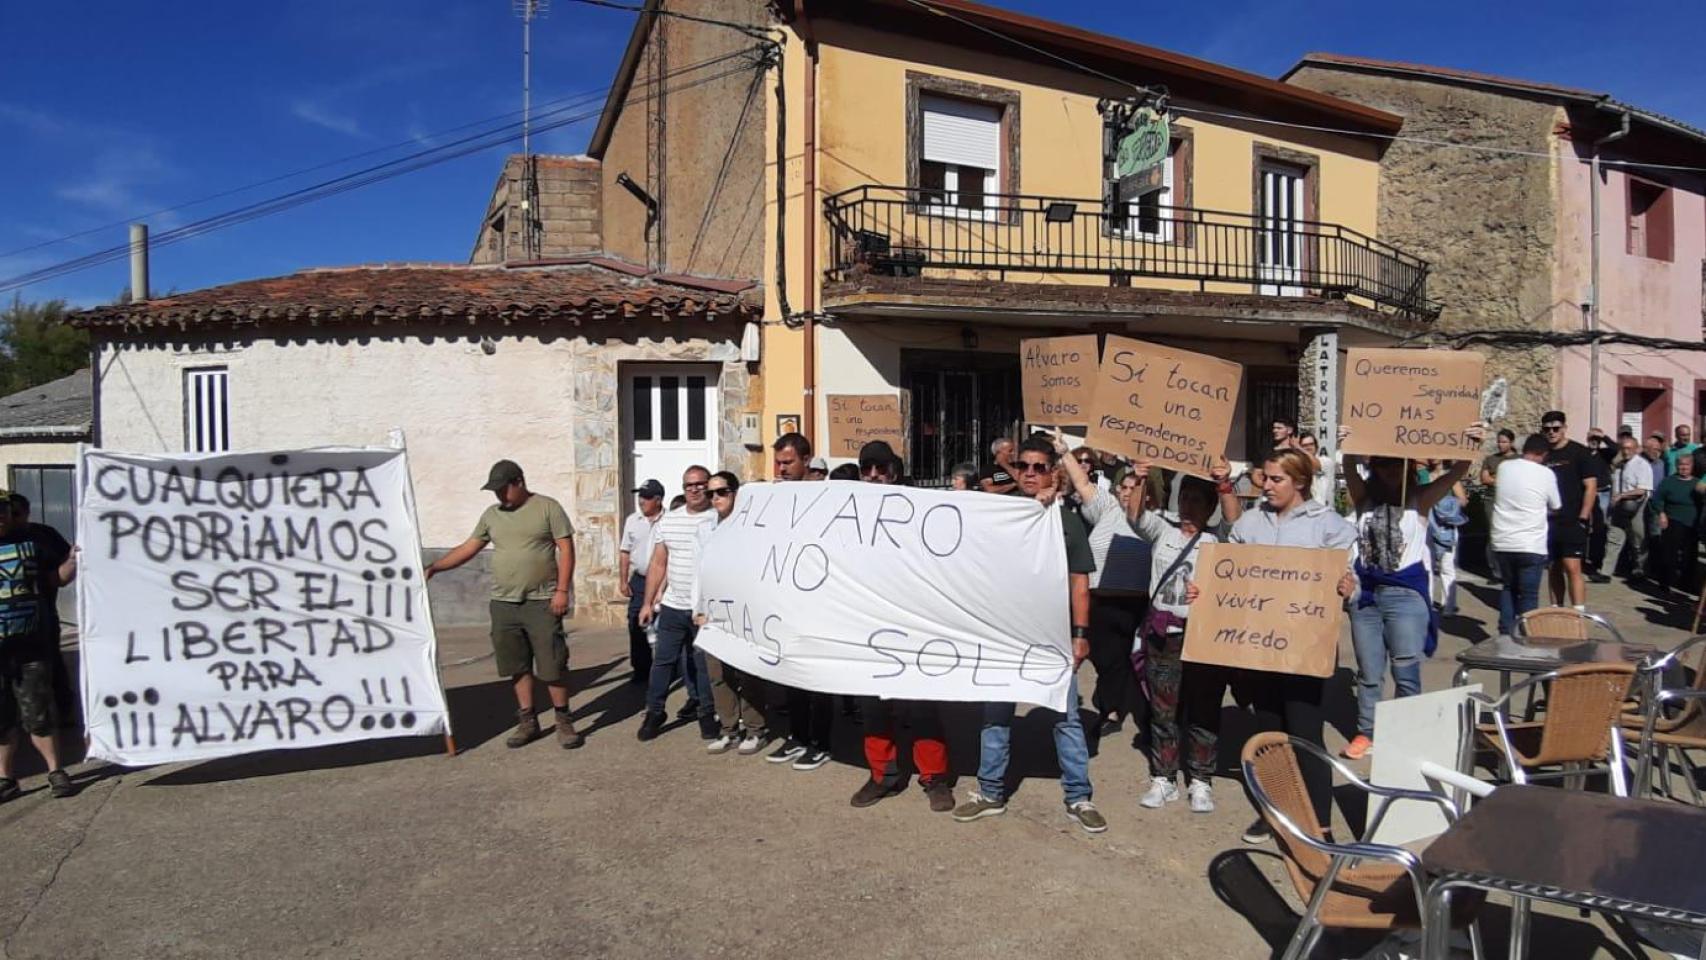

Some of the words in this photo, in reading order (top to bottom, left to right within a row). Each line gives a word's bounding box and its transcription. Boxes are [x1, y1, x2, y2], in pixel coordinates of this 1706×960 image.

[1024, 344, 1080, 369] Alvaro
[1355, 358, 1439, 378] Queremos
[1110, 351, 1148, 383] Si
[1166, 363, 1229, 402] tocan
[1040, 397, 1079, 415] todos
[1129, 392, 1143, 409] a
[1351, 402, 1383, 419] NO
[1400, 405, 1435, 421] MAS
[1100, 414, 1207, 451] respondemos
[732, 487, 963, 557] ALVARO
[760, 543, 829, 591] NO
[1214, 558, 1323, 582] Queremos
[171, 567, 280, 612] SER
[1286, 601, 1325, 618] sin
[124, 618, 395, 664] LIBERTAD
[1214, 627, 1288, 651] miedo
[868, 628, 1070, 687] SOLO
[207, 657, 322, 692] PARA
